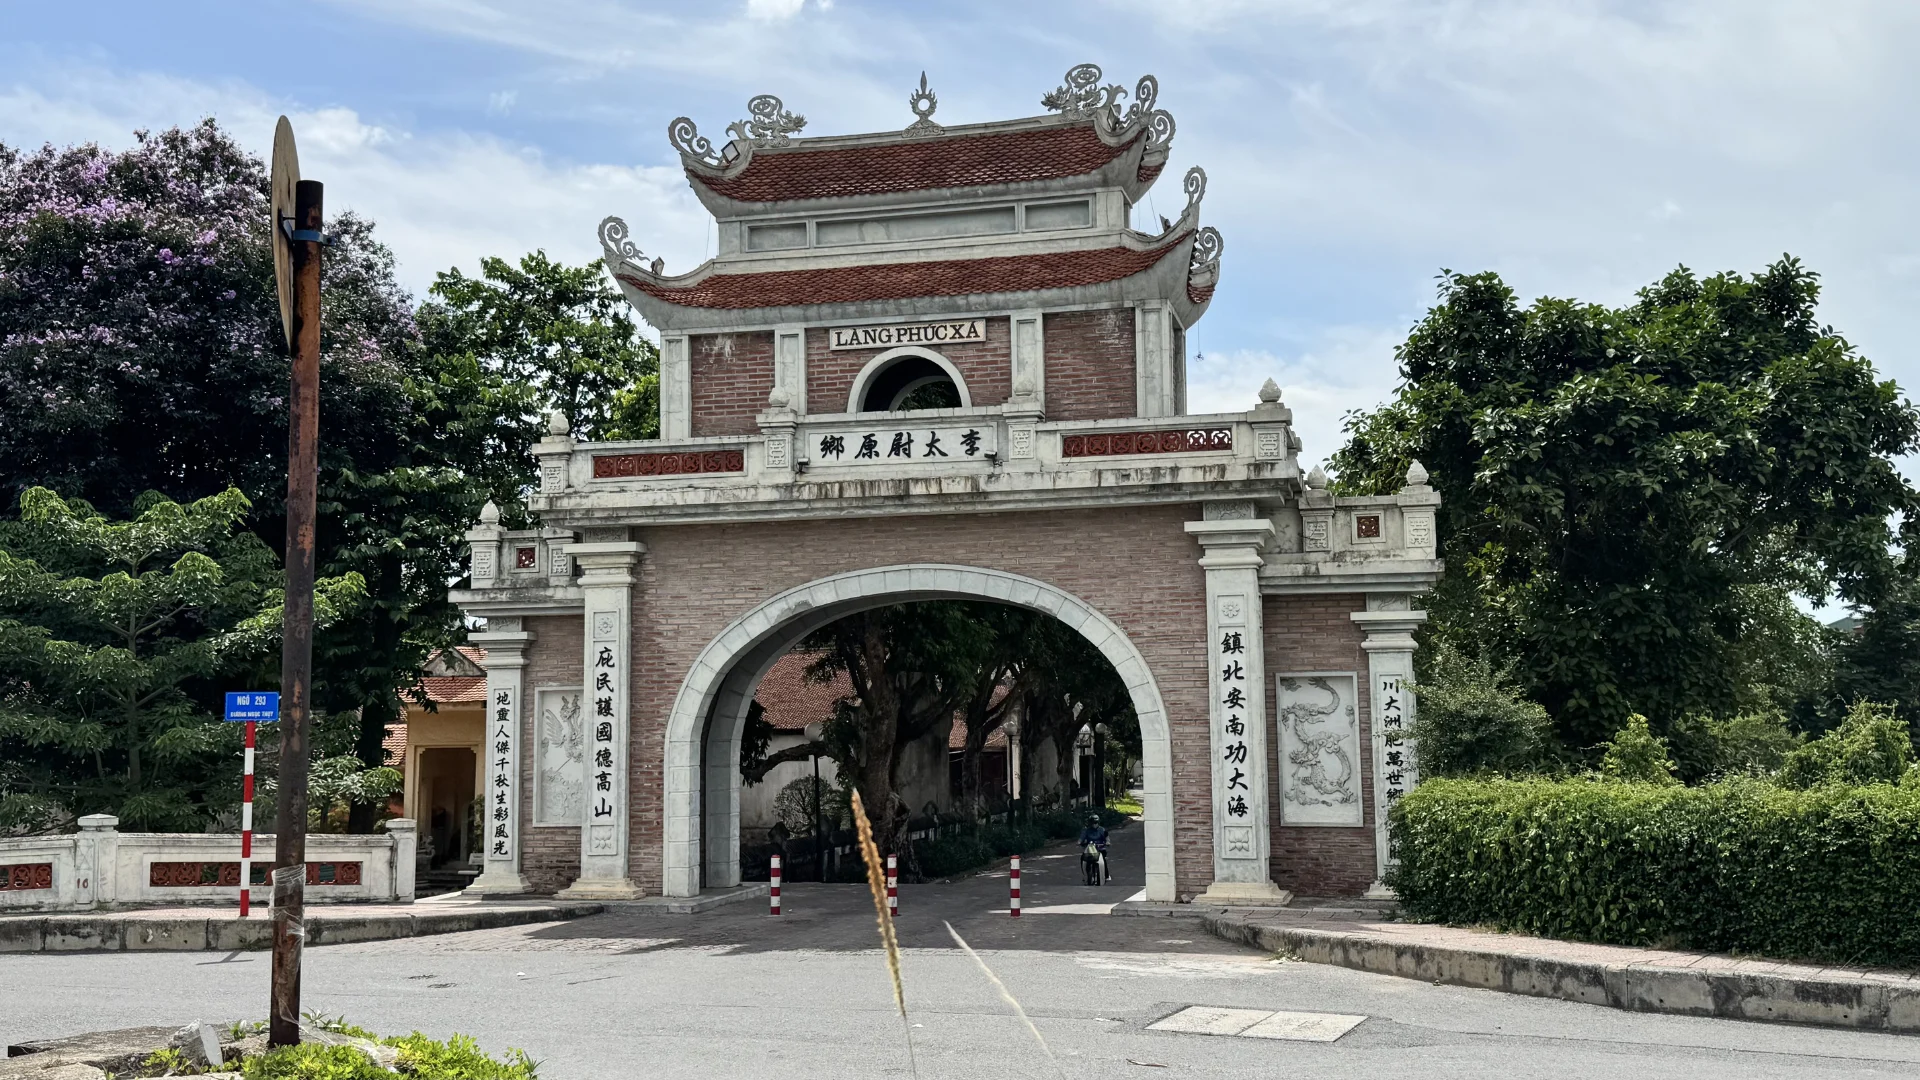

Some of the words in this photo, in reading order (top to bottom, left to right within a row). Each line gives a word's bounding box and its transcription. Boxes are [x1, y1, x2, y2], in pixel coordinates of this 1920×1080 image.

[835, 328, 893, 347] LÀNG
[895, 323, 948, 343] PHÚC
[949, 321, 980, 339] XÁ
[255, 695, 266, 705] 293
